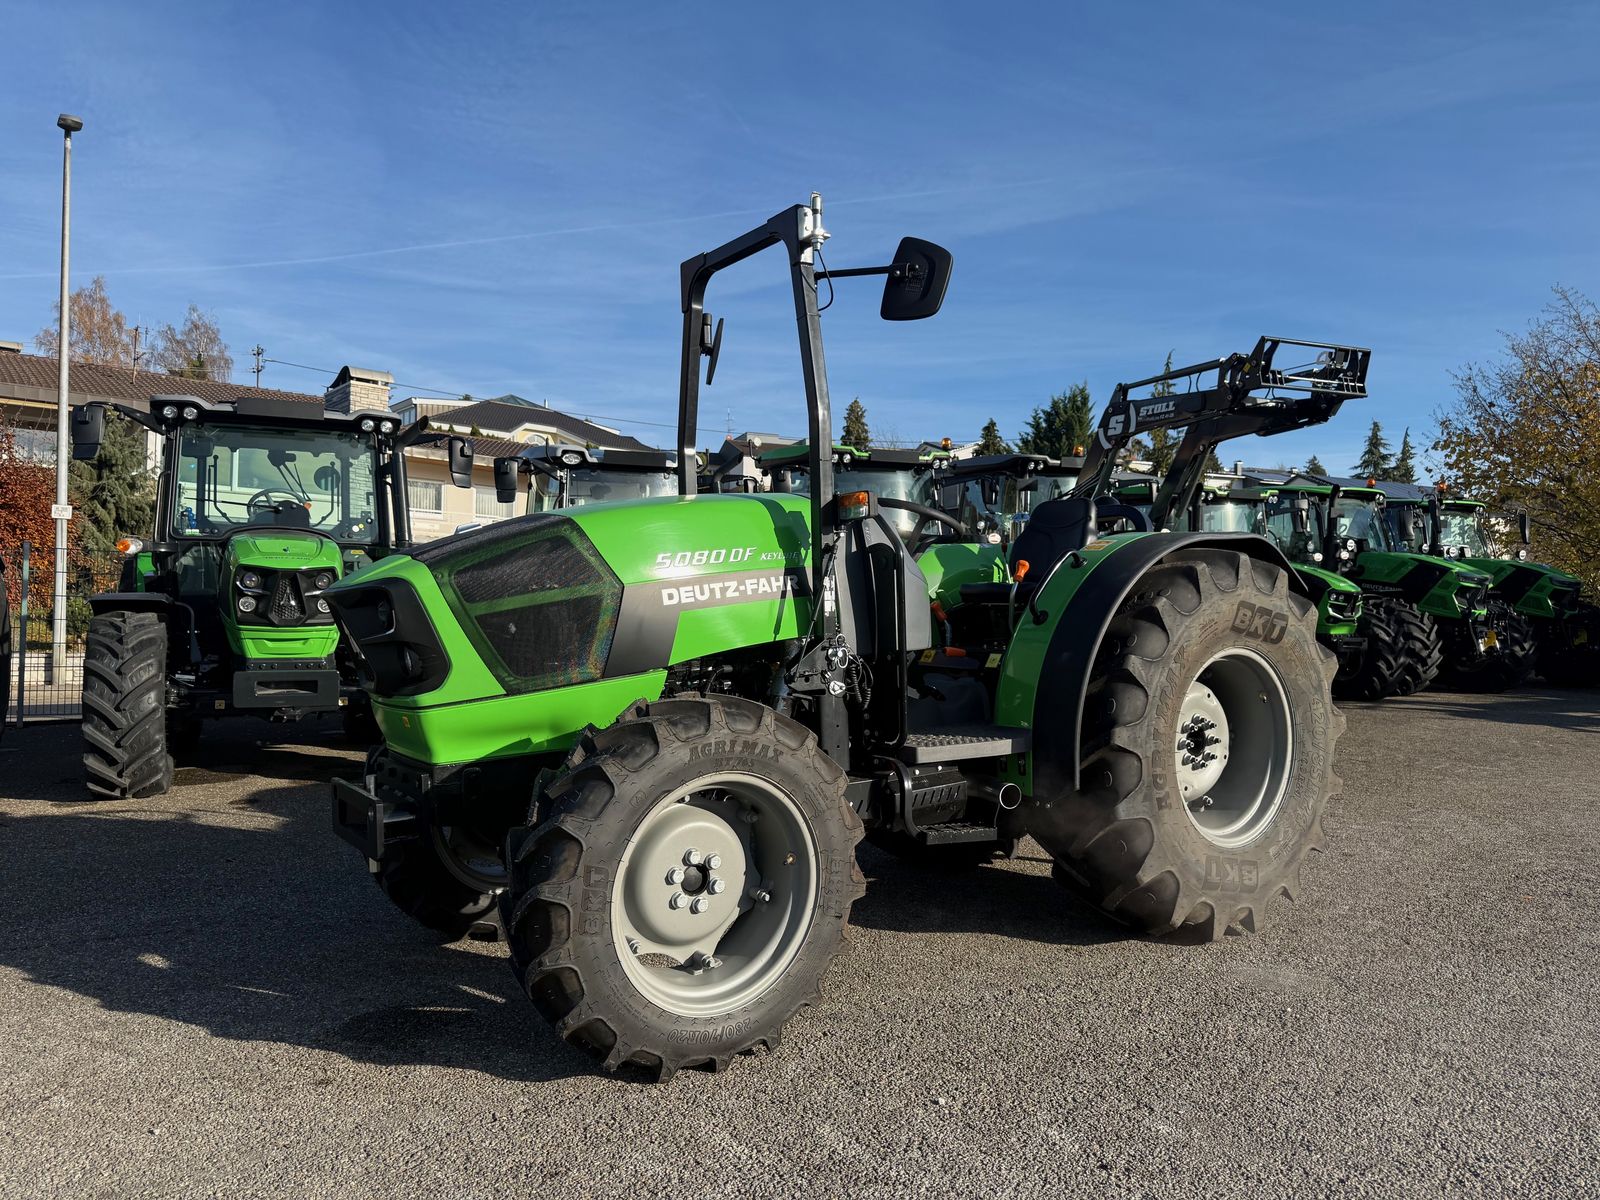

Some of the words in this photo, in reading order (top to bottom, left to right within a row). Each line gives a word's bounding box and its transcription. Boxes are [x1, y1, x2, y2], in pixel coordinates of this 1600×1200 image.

[1139, 401, 1176, 417] STOLL
[661, 574, 800, 606] DEUTZ-FAHR
[1231, 602, 1289, 643] BKT
[1205, 857, 1258, 889] BKT
[582, 867, 607, 935] BKT
[667, 1017, 751, 1046] 280/70R20
